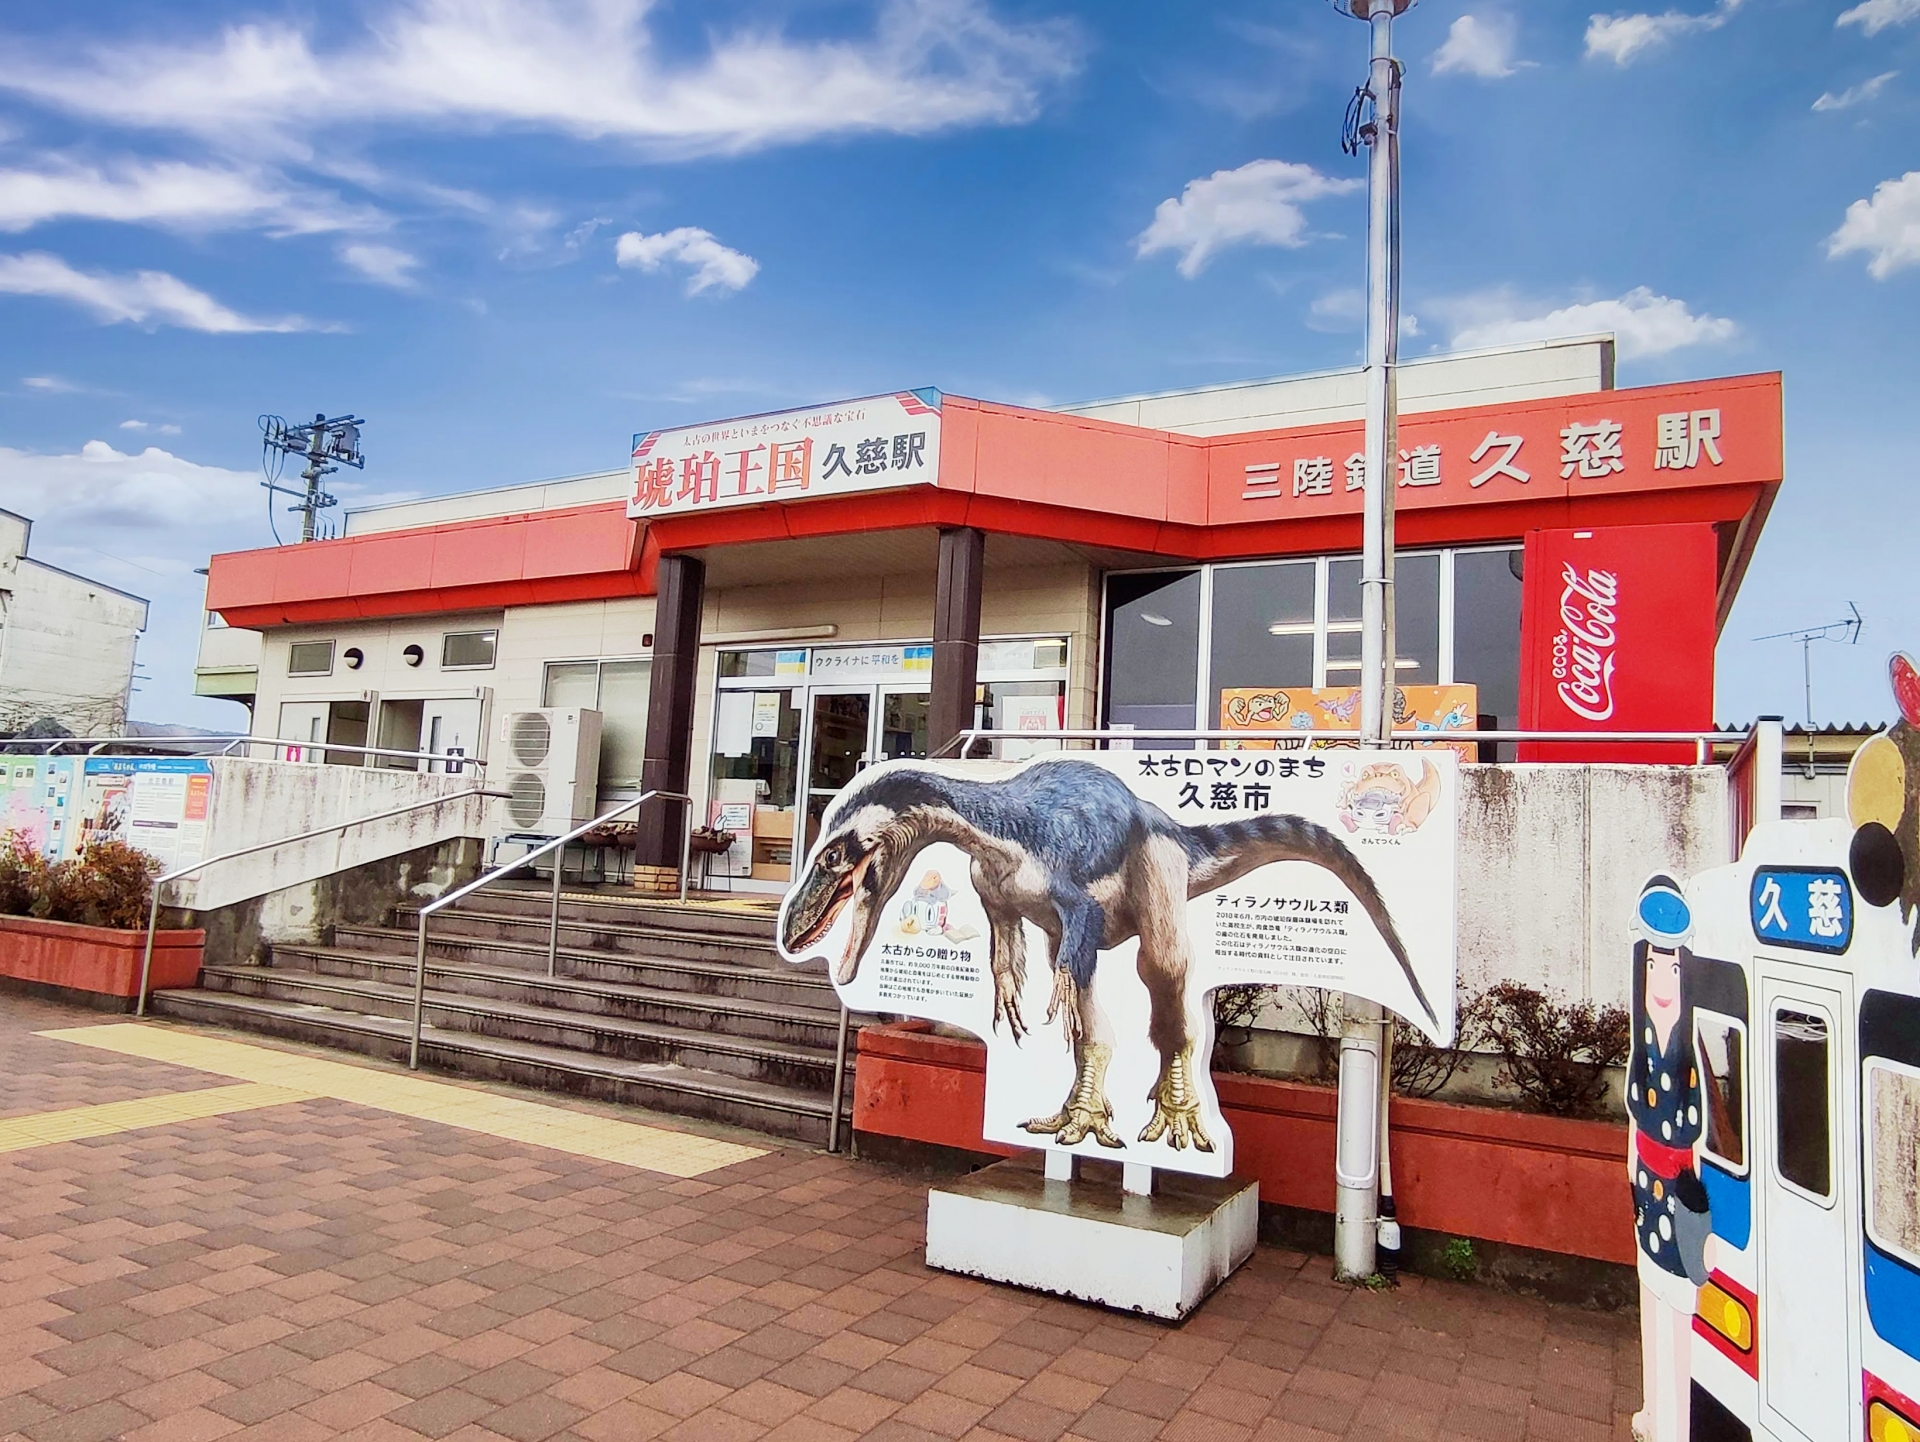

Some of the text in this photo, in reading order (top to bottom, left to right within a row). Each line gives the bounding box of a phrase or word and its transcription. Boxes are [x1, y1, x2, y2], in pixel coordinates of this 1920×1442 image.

[1468, 408, 1723, 488] 久慈駅
[632, 432, 926, 511] 琥珀王国 久慈駅
[1557, 560, 1618, 721] Coca-Cola
[815, 654, 900, 668] ウクライナに平和を
[1138, 754, 1326, 778] 太古ロマンのまち
[1178, 781, 1272, 811] 久慈市
[1361, 837, 1401, 846] さんてつくん
[1215, 894, 1349, 914] ティラノサウルス類
[1758, 876, 1843, 937] 久慈
[881, 943, 971, 963] 太古からの贈り物
